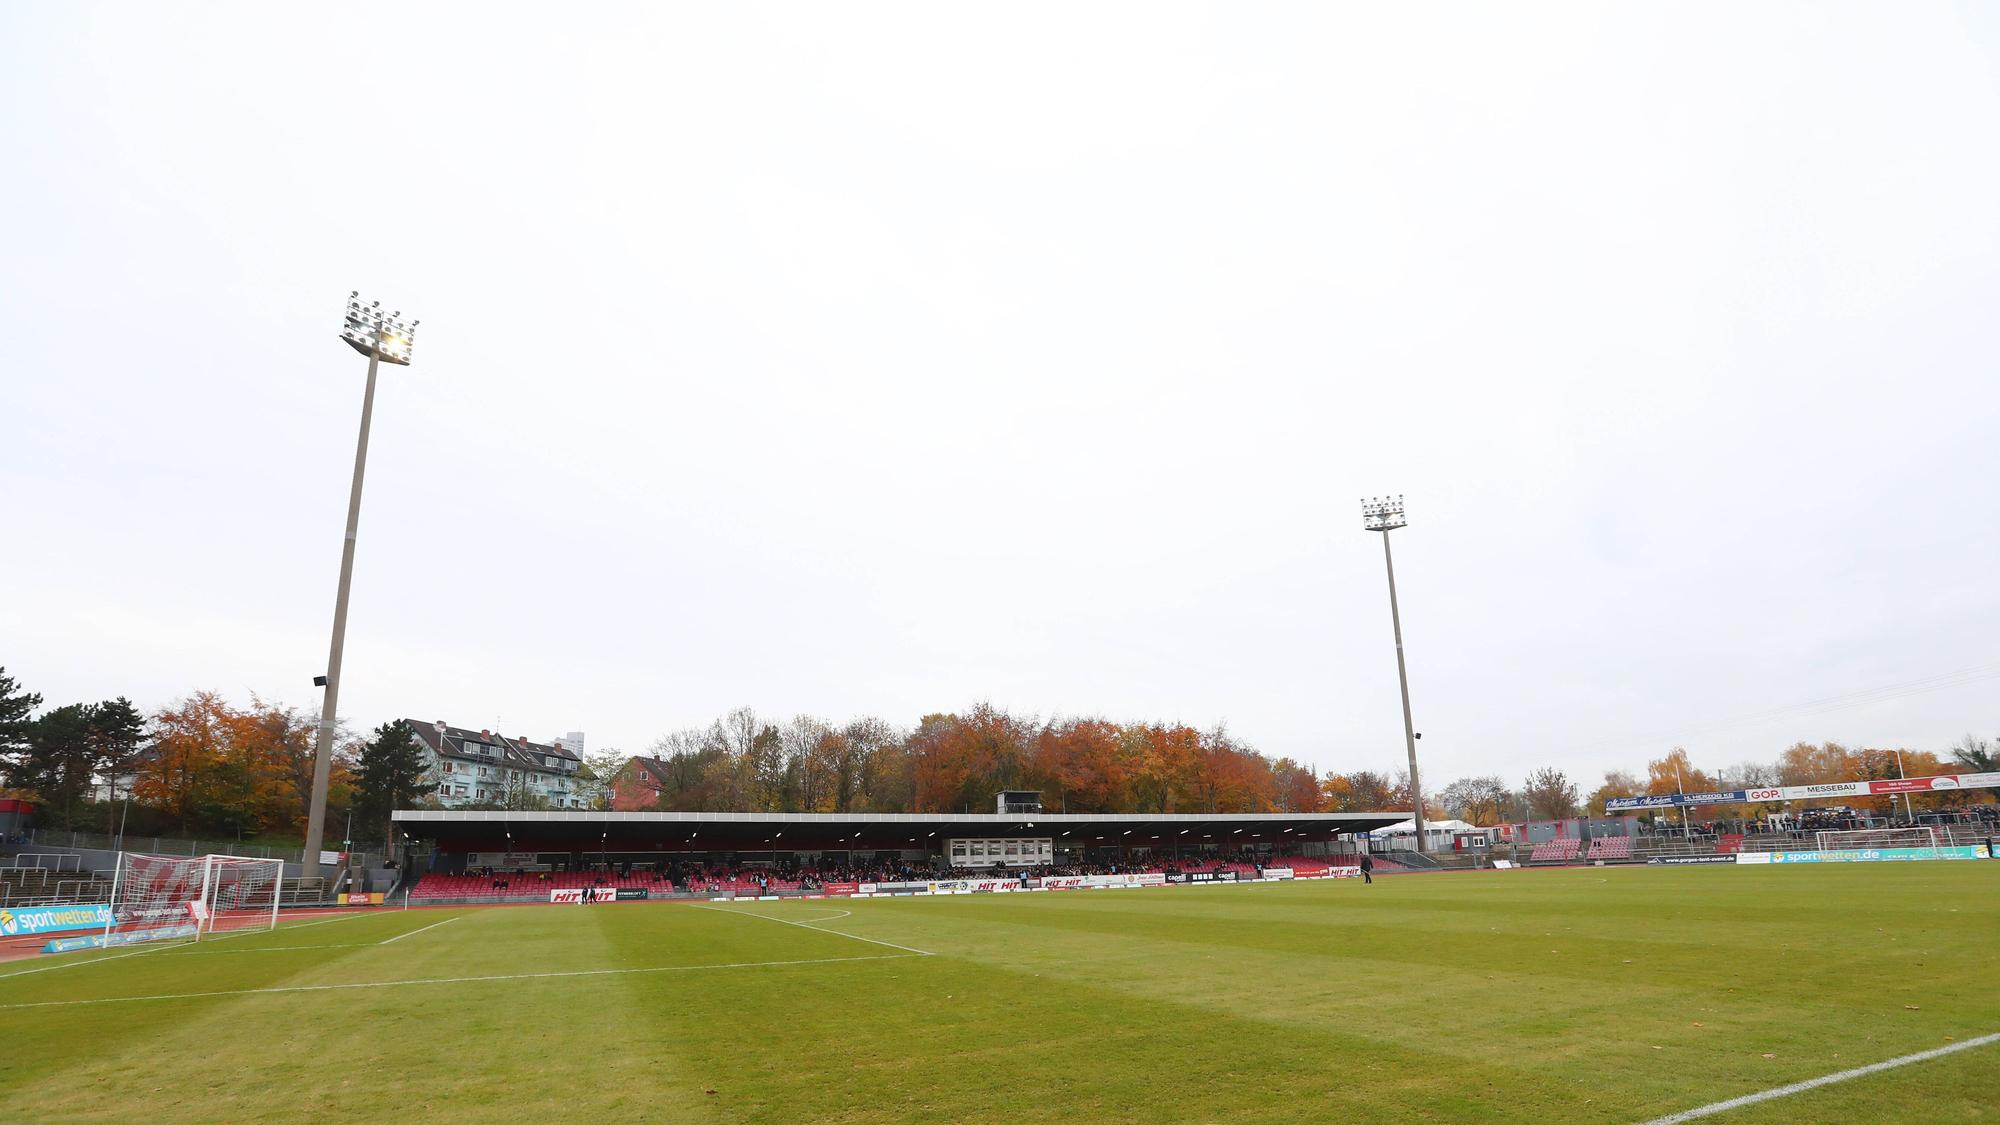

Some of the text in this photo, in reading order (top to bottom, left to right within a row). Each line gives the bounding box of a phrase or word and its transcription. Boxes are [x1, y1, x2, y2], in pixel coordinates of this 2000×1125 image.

[1807, 784, 1856, 793] MESSEBAU
[1751, 790, 1780, 799] GOP.
[978, 881, 1020, 890] HIT HIT
[553, 893, 580, 902] HIT
[18, 905, 112, 933] sportwetten.de
